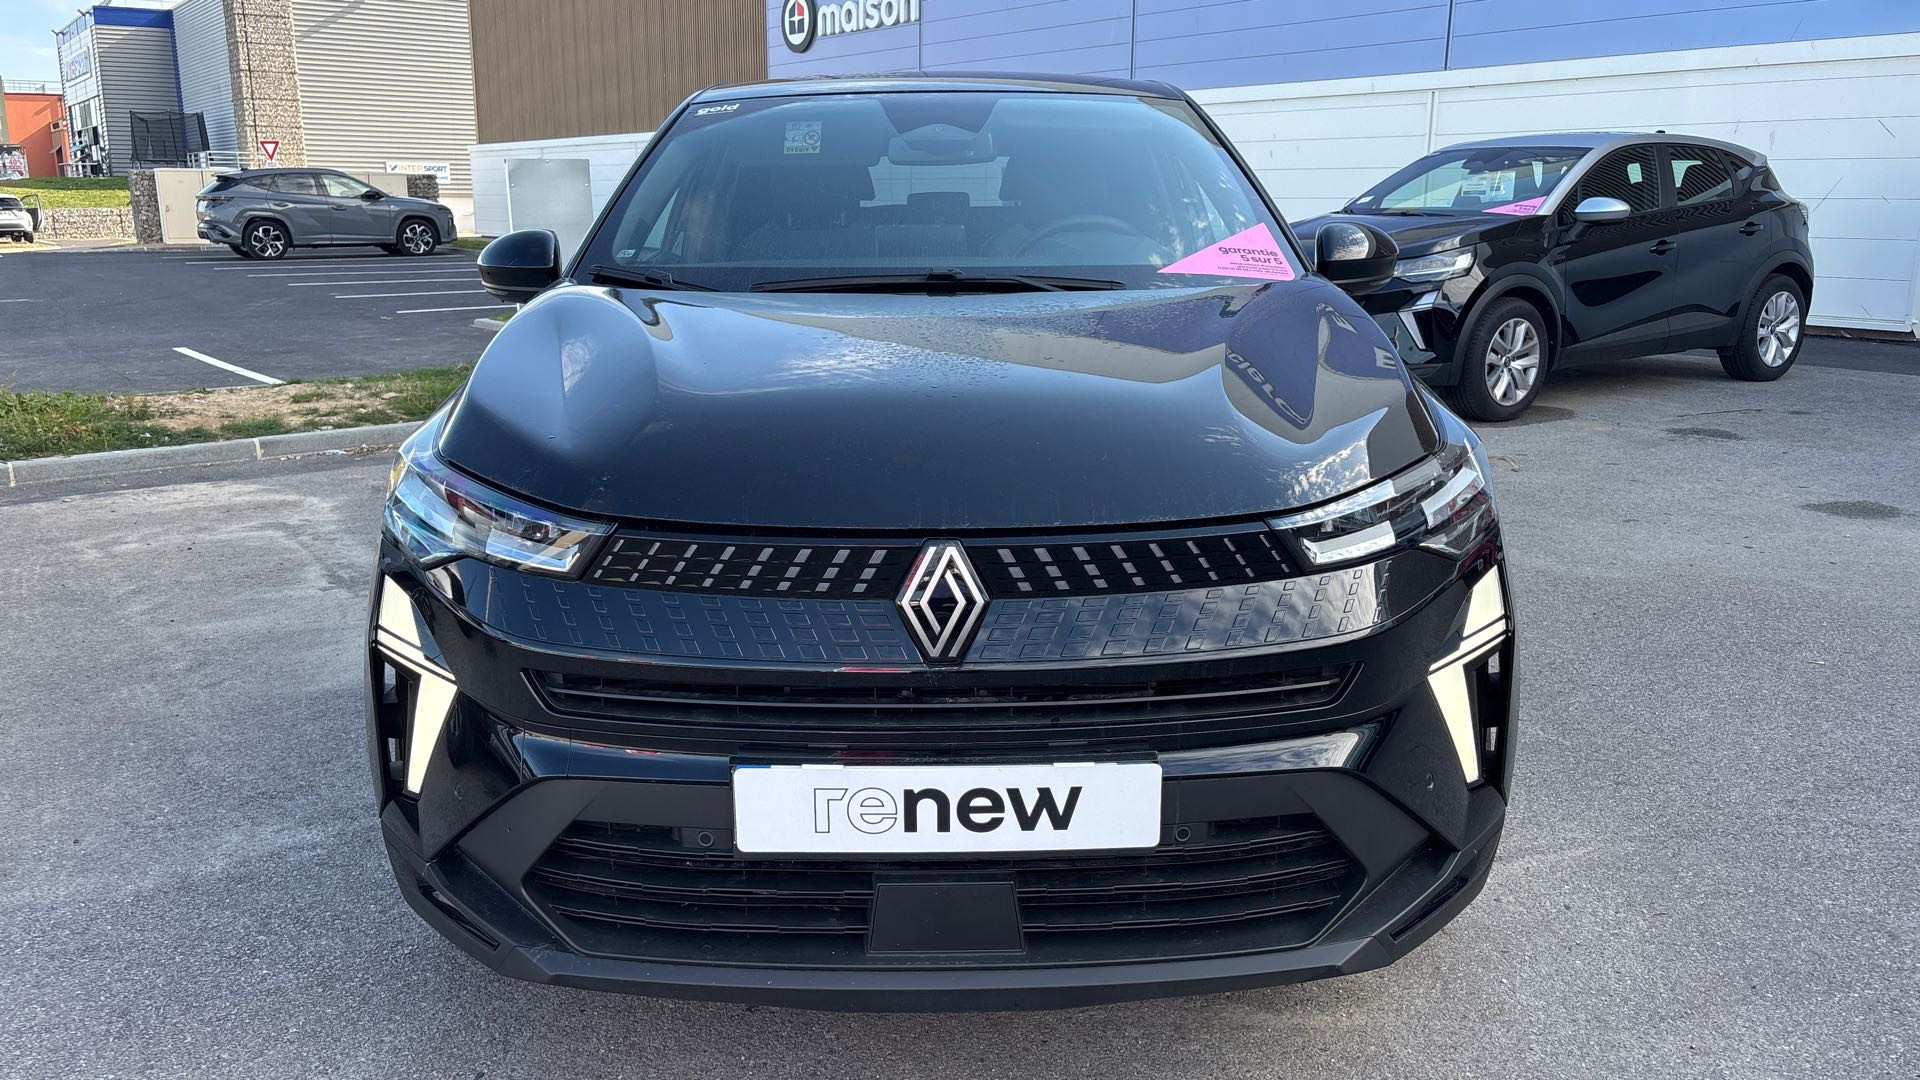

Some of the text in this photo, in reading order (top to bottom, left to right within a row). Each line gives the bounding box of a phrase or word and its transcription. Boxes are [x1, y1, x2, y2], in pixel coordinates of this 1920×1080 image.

[817, 0, 919, 36] maison
[694, 103, 740, 117] gold
[1218, 246, 1279, 257] garantie
[1240, 254, 1251, 262] 5
[1251, 256, 1272, 264] sur
[1274, 257, 1284, 265] 5
[813, 785, 1083, 835] renew
